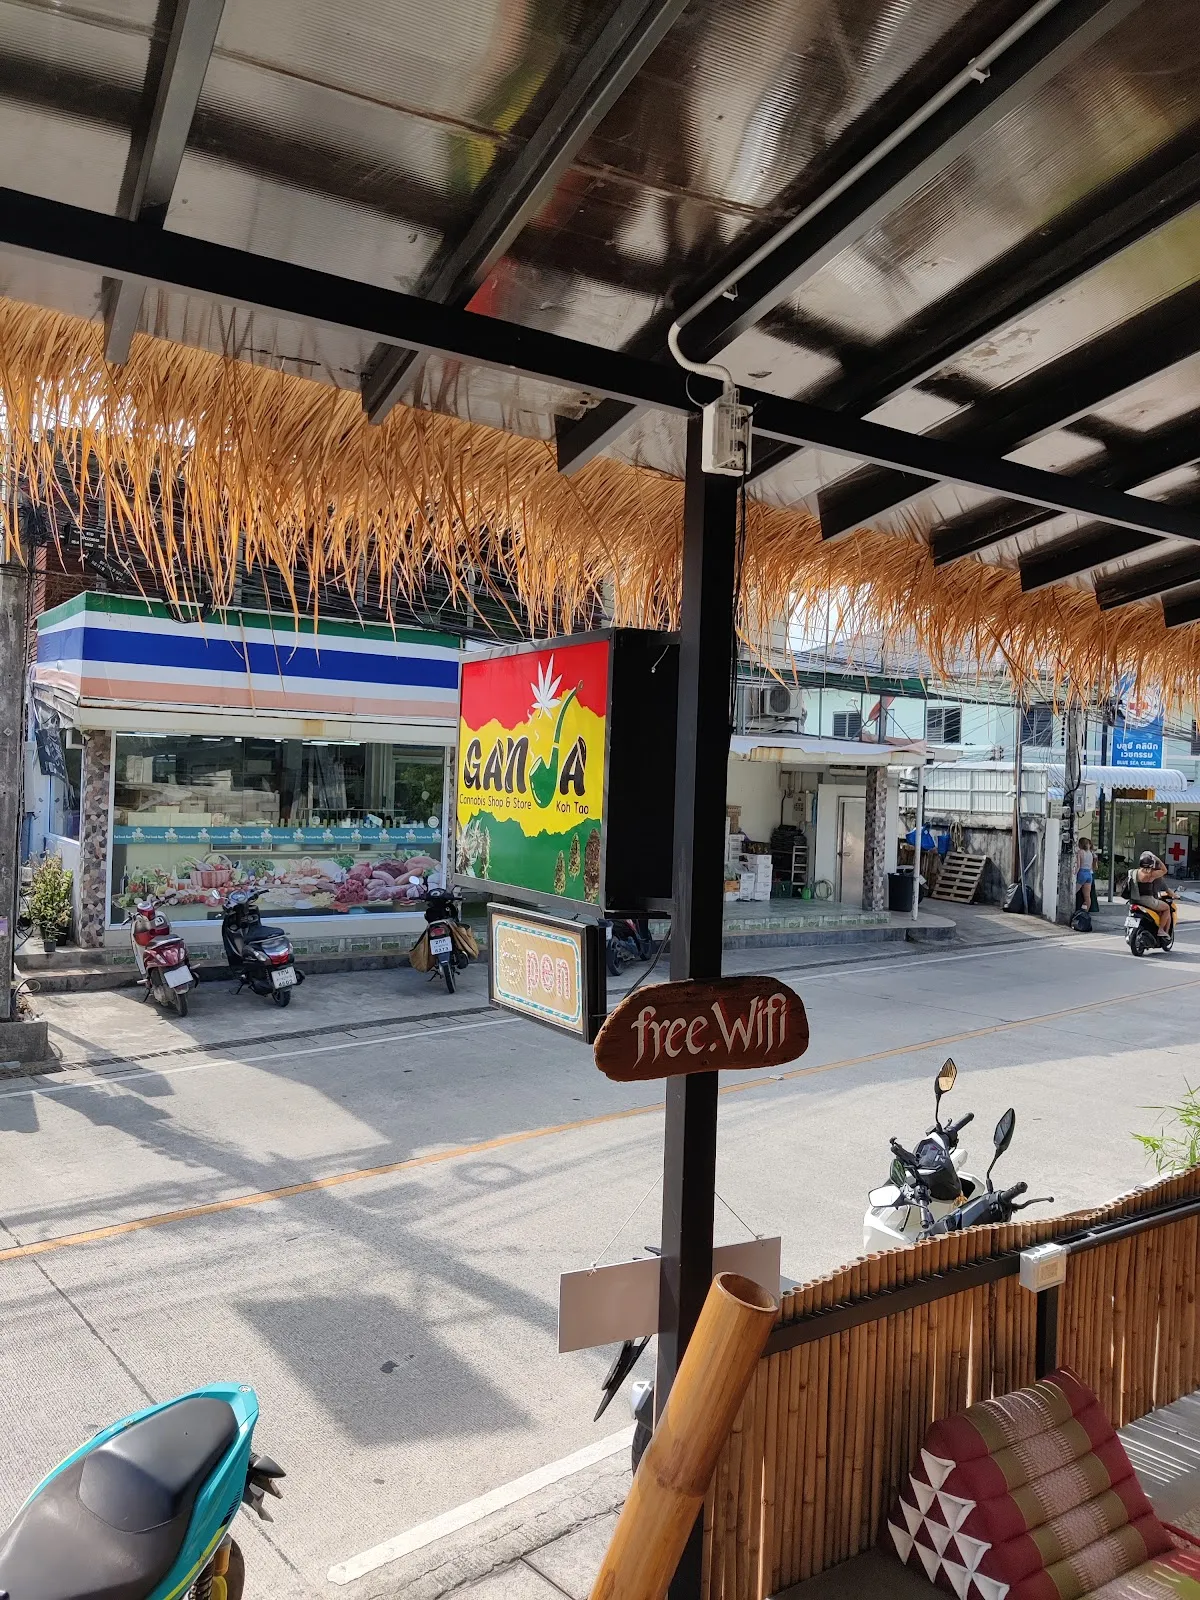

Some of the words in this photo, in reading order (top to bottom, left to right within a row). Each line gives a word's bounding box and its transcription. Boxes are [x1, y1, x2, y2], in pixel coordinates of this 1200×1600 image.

[1136, 742, 1158, 750] คลินิก
[463, 732, 588, 809] GANJA
[459, 793, 486, 807] Cannabis
[488, 796, 504, 810] Shop
[505, 797, 511, 809] &
[513, 797, 532, 810] Store
[556, 801, 571, 813] Koh
[573, 801, 589, 815] Tao
